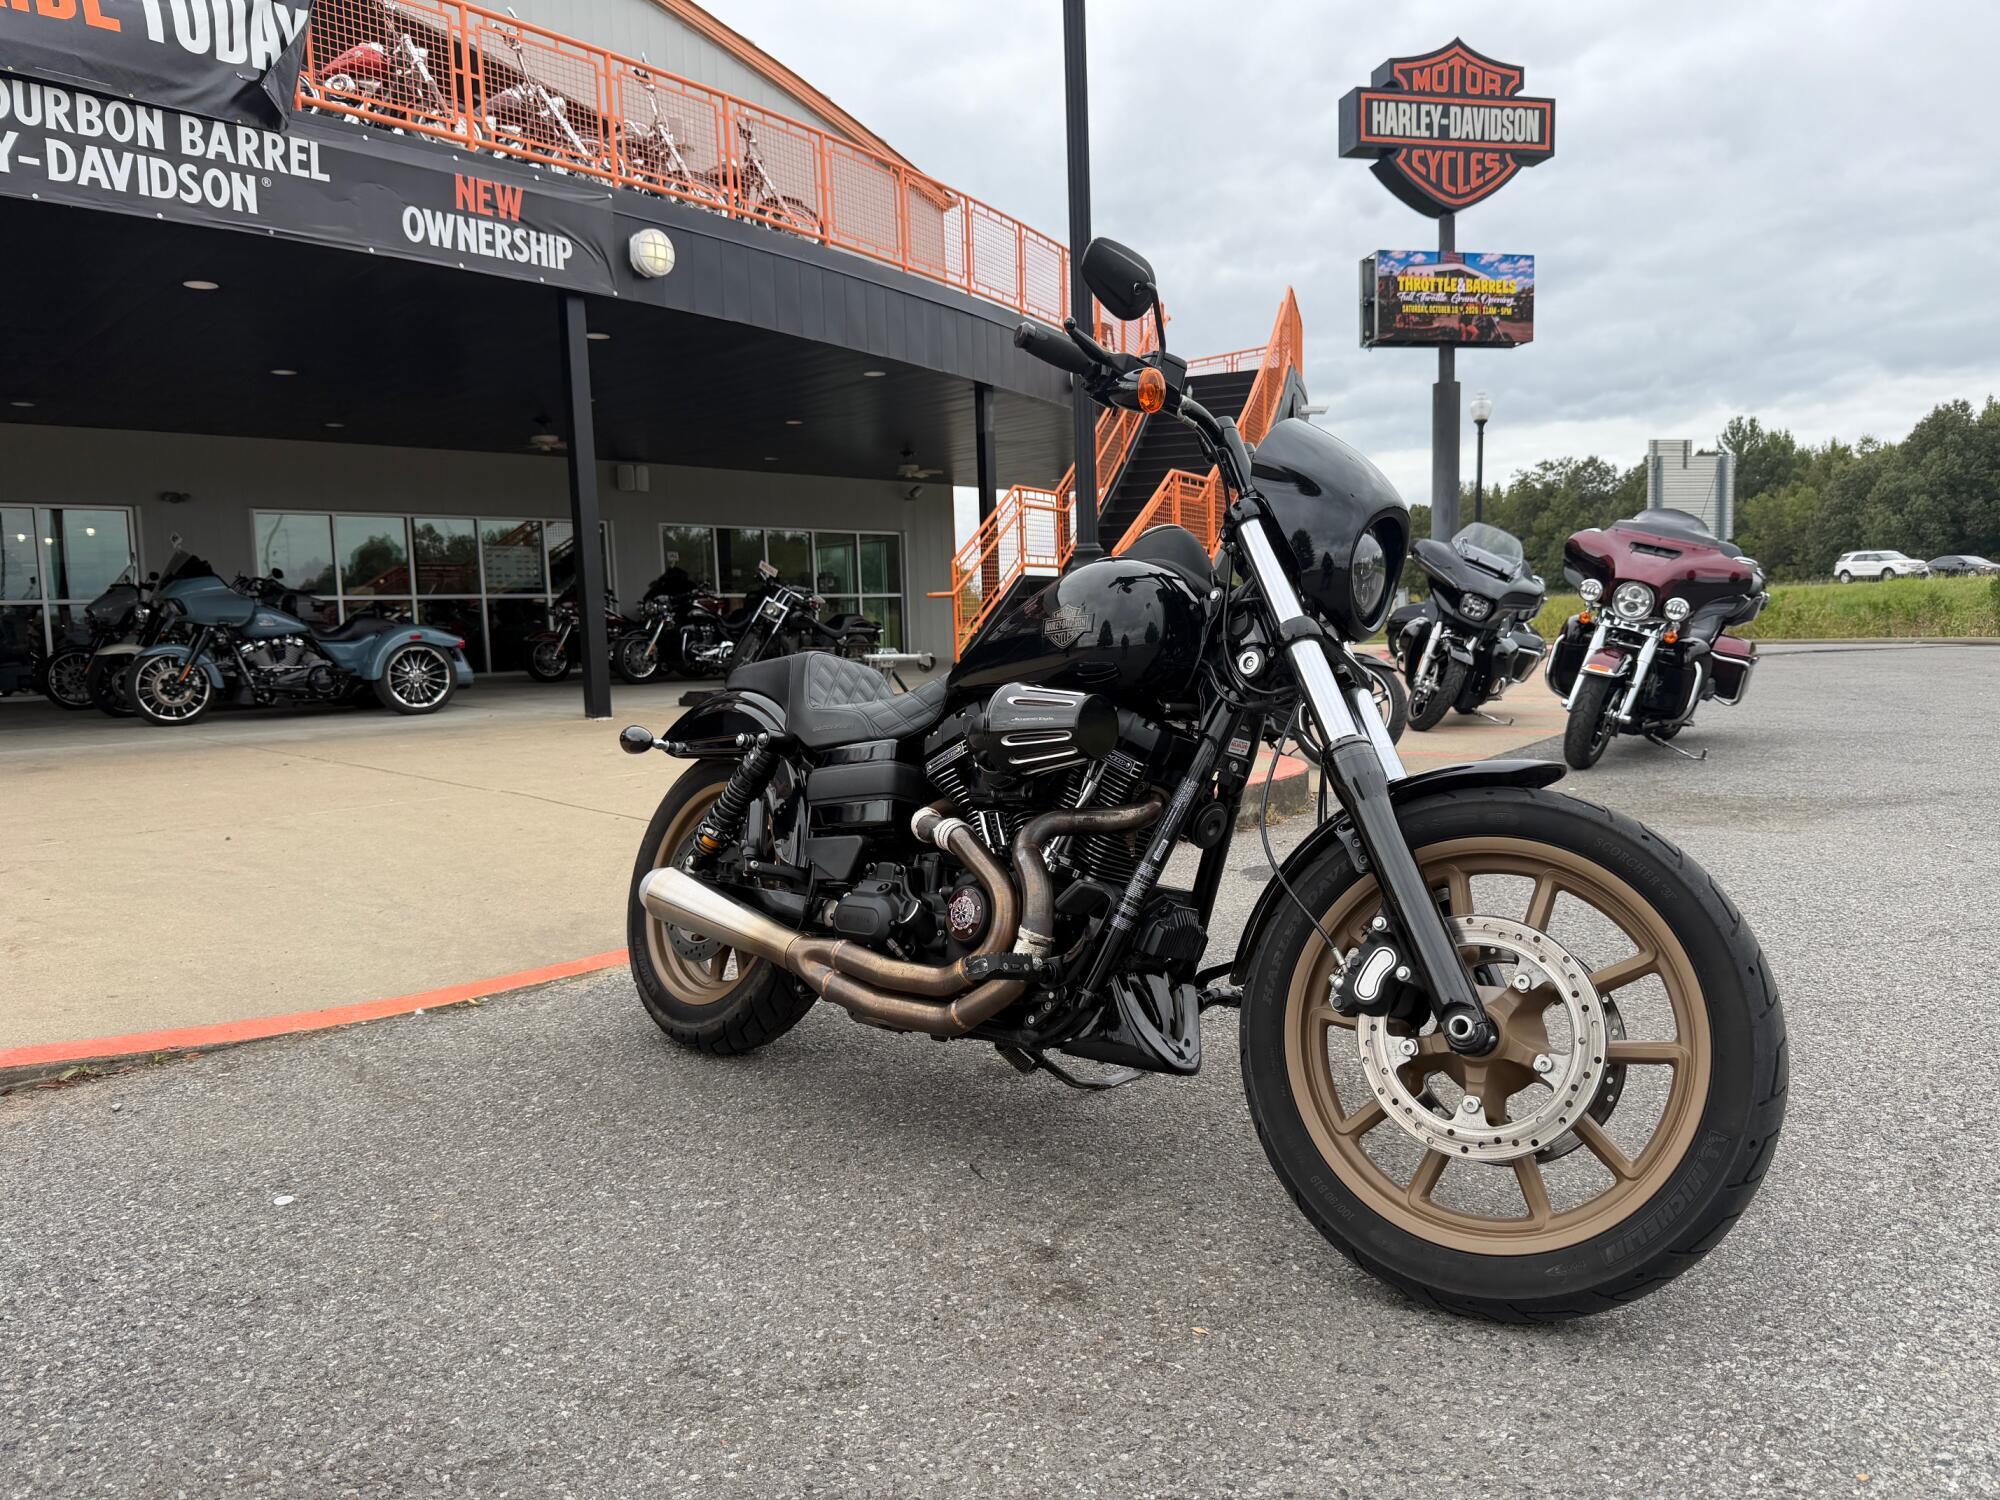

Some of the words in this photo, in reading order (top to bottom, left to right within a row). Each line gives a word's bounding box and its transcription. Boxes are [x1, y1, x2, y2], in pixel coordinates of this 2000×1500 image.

[1412, 55, 1501, 96] MOTOR
[1371, 101, 1540, 143] HARLEY-DAVIDSON
[180, 114, 331, 182] BARREL
[1411, 149, 1501, 195] CYCLES
[455, 173, 524, 222] NEW
[402, 205, 573, 270] OWNERSHIP
[1451, 293, 1480, 304] Grand
[1594, 838, 1660, 886] SCORCHER
[1605, 1163, 1711, 1264] MICHELIN
